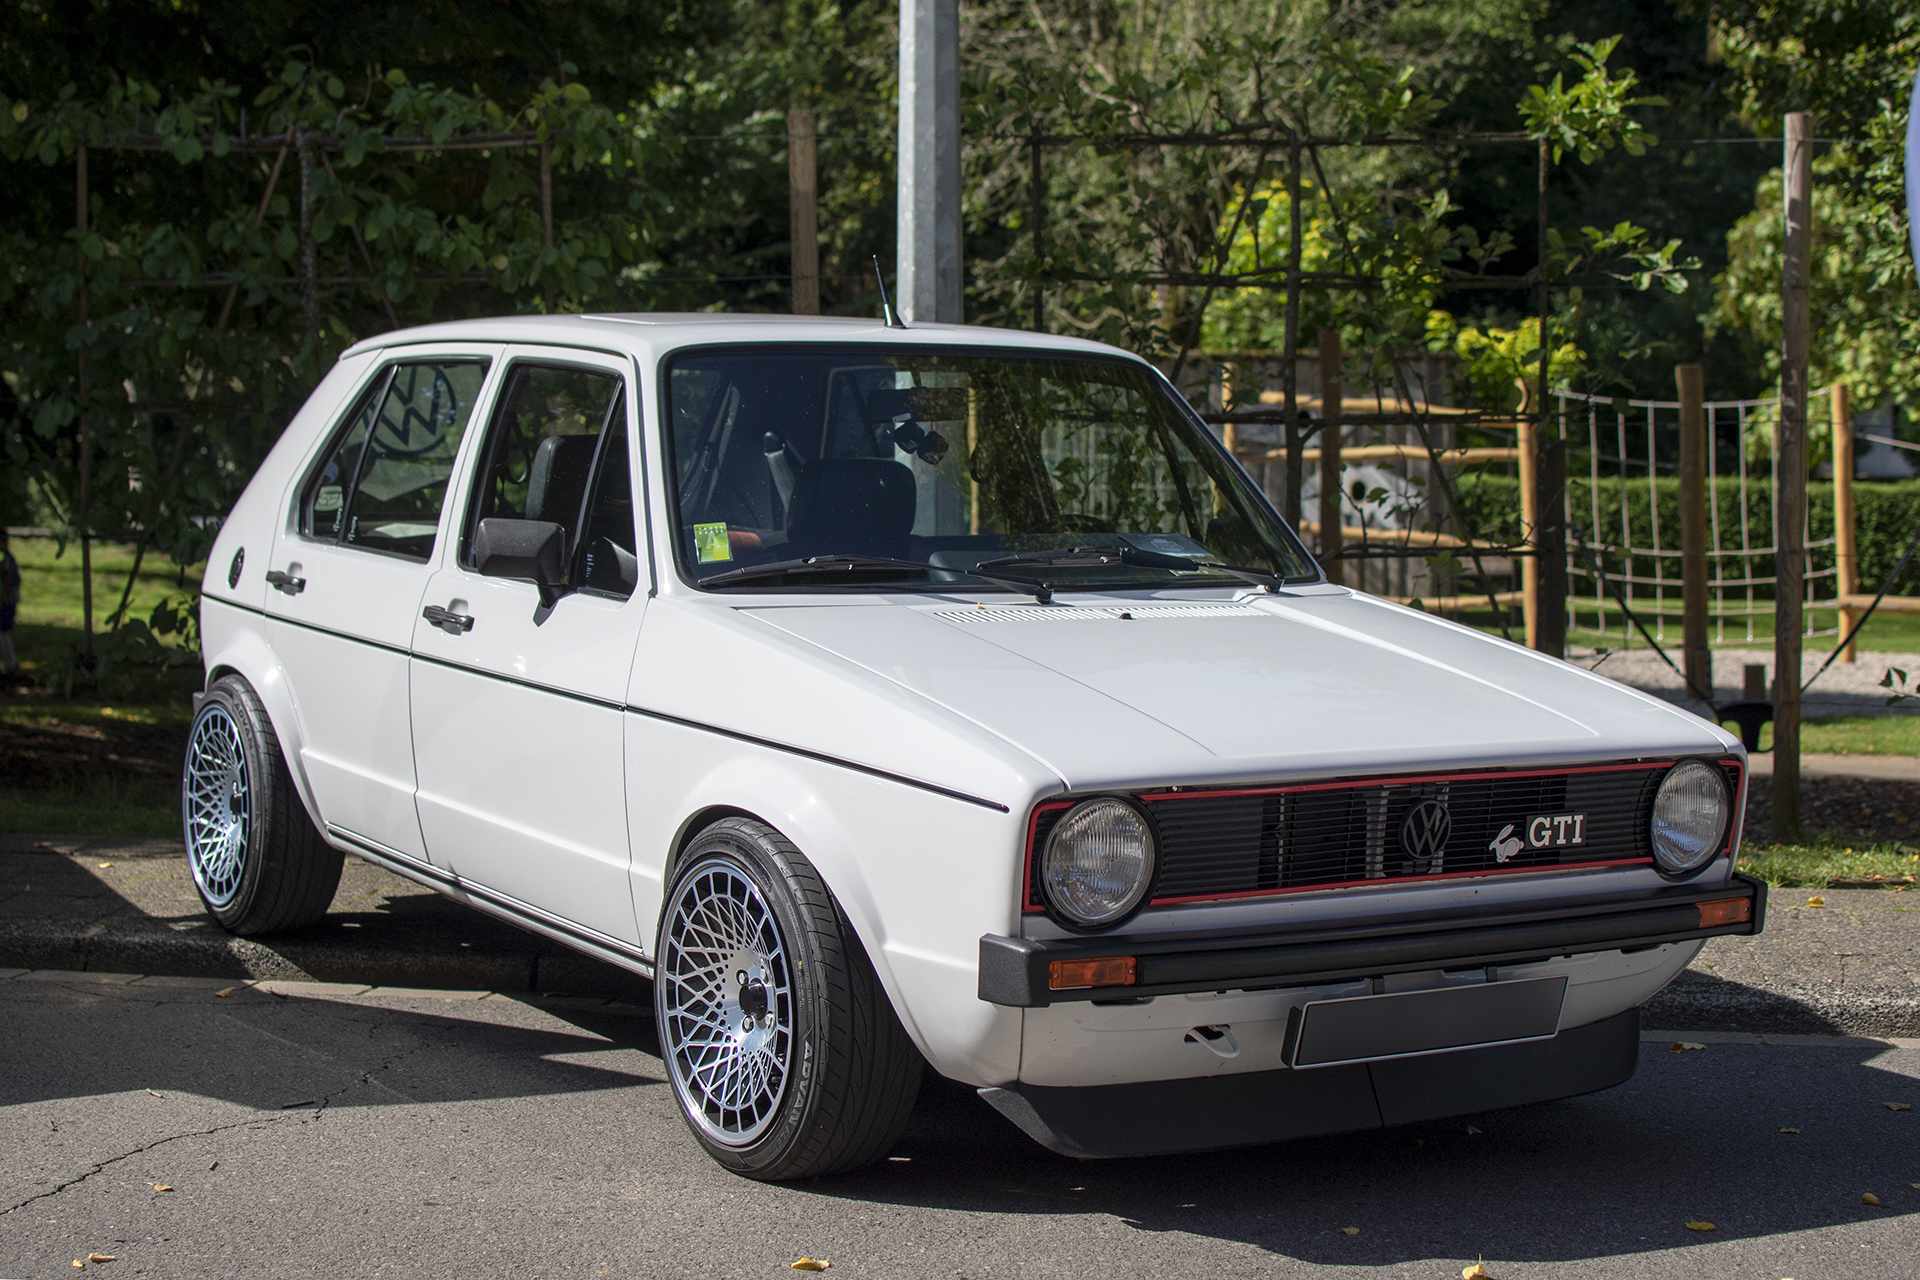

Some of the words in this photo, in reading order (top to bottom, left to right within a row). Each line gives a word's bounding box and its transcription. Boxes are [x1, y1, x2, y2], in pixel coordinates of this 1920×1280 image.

[234, 703, 254, 750] ADVAN
[1404, 802, 1450, 857] VW
[1528, 814, 1584, 848] GTI
[788, 1040, 813, 1126] ADVAN
